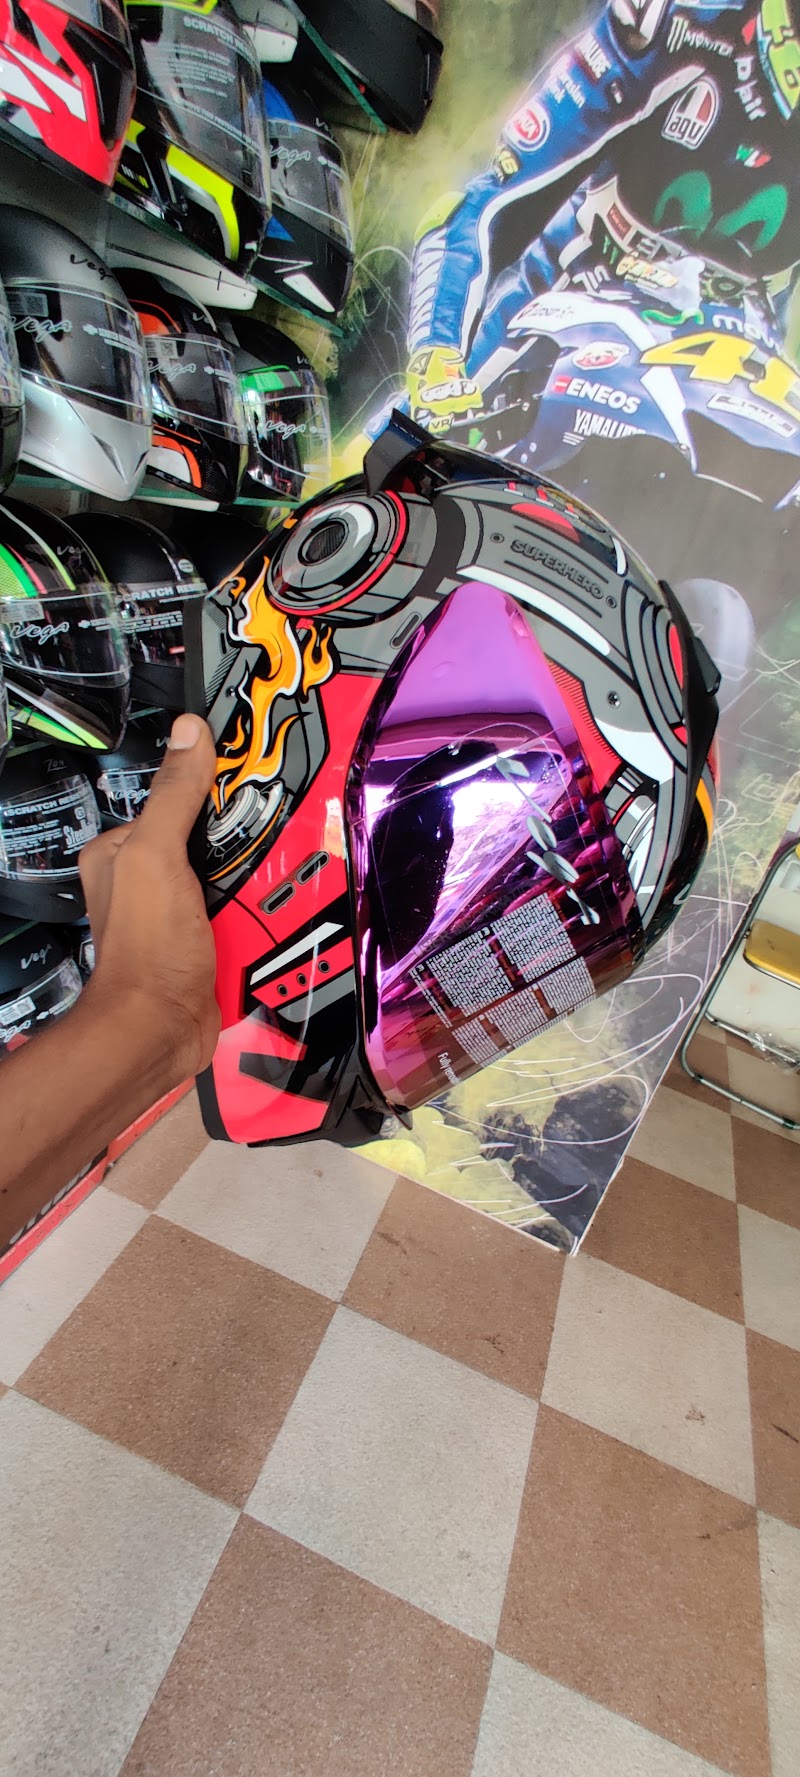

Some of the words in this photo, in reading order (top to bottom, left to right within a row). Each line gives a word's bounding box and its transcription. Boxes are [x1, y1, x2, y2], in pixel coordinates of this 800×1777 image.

[668, 115, 704, 142] agv
[565, 377, 641, 414] ENEOS
[510, 540, 604, 600] SUPERHERO
